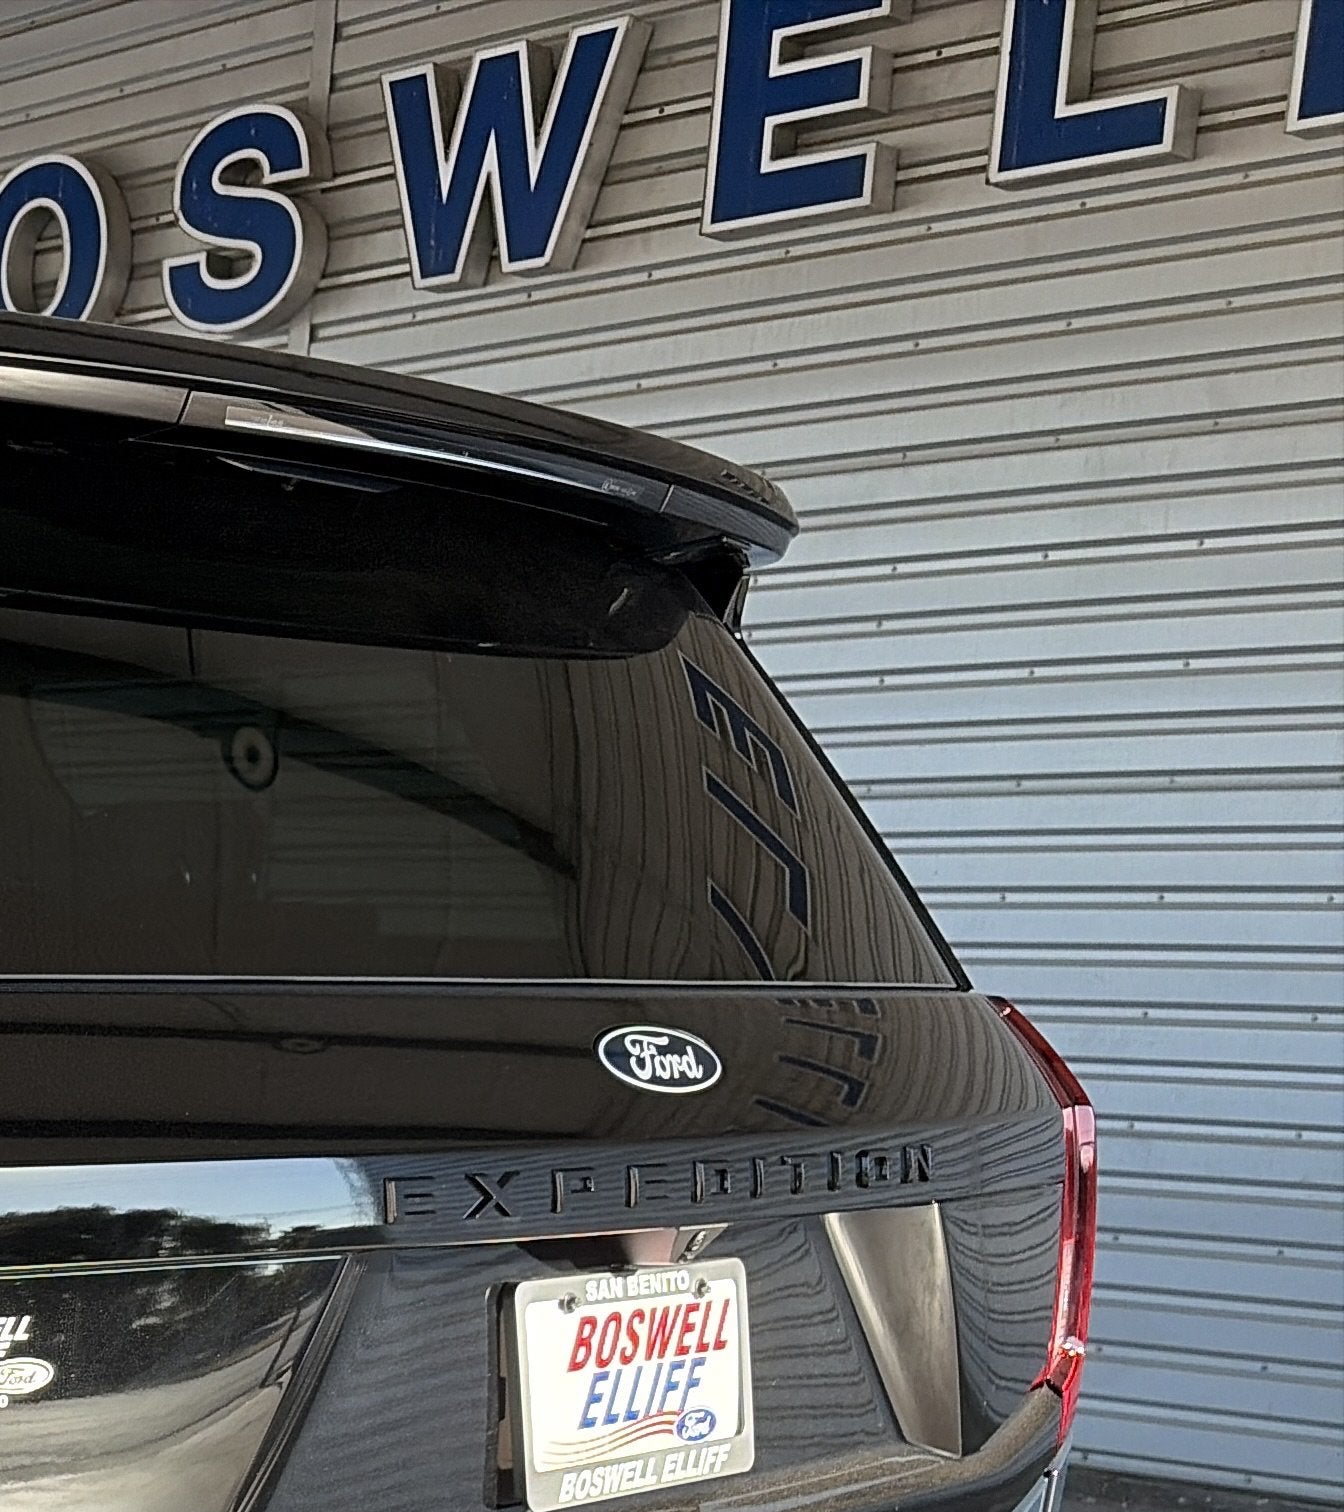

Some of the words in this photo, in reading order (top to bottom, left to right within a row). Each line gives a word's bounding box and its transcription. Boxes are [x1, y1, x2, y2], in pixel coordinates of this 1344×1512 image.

[623, 1034, 704, 1081] Ford
[383, 1143, 933, 1226] EXPEDITION
[585, 1280, 624, 1301] SAN
[626, 1270, 690, 1296] BENITO
[566, 1298, 730, 1372] BOSWELL
[577, 1356, 706, 1430] ELLIFF
[558, 1457, 659, 1503] BOSWELL
[660, 1443, 731, 1483] ELLIFF
